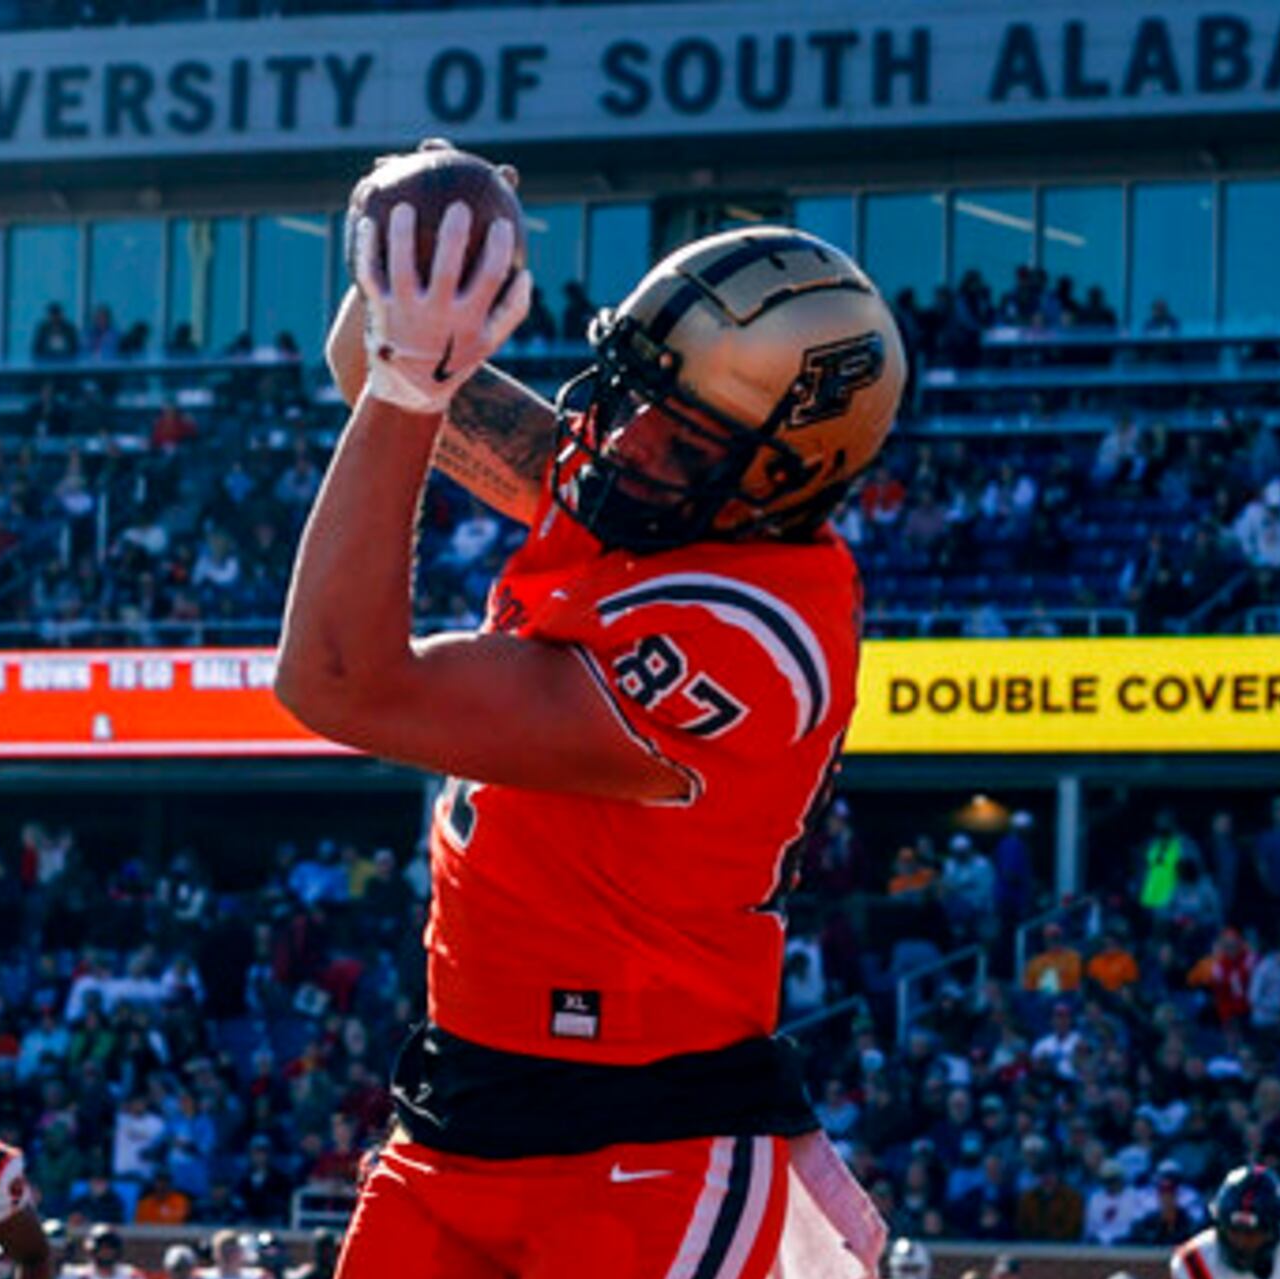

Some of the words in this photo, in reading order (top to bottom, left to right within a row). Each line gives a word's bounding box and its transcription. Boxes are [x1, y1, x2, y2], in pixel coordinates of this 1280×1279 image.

[425, 45, 548, 124] OF
[598, 28, 932, 119] SOUTH
[613, 632, 751, 740] 87
[888, 677, 1100, 715] DOUBLE
[563, 993, 590, 1011] XL
